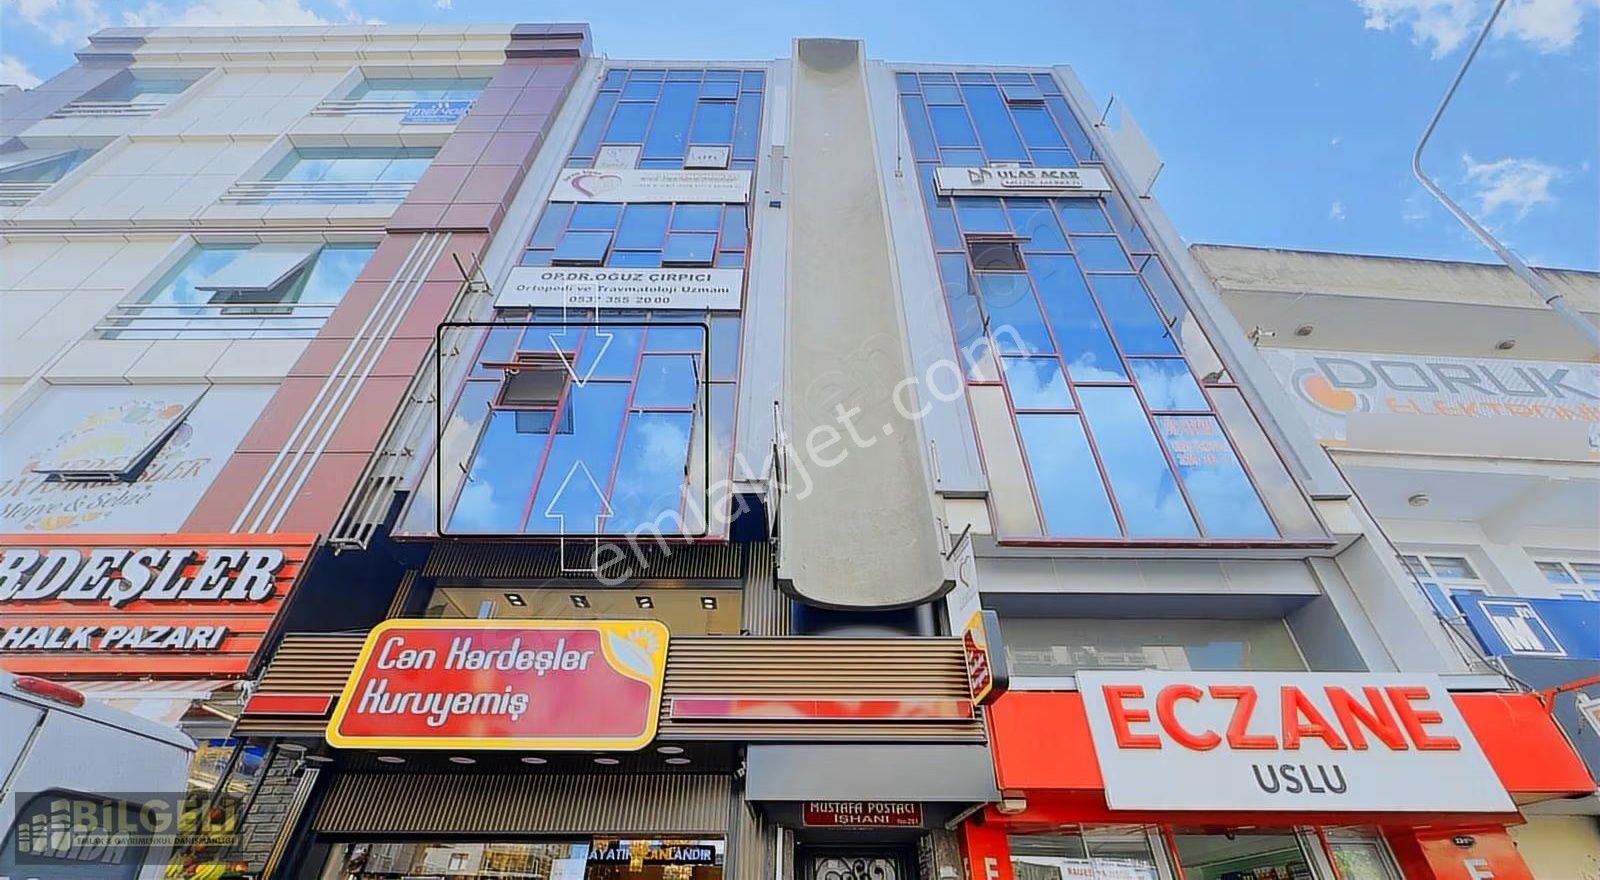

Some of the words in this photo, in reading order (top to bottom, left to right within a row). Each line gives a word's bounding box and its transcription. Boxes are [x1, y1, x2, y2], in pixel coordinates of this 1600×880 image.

[516, 284, 573, 293] Ortopedi
[597, 284, 678, 294] Travmatoloji
[1314, 356, 1600, 399] DORUK
[0, 626, 95, 650] HALK
[98, 626, 229, 650] PAZARI
[377, 636, 437, 671] Can
[1101, 683, 1462, 752] ECZANE
[1252, 763, 1348, 795] USLU
[810, 802, 863, 815] MUSTAFA
[867, 802, 915, 815] POSTACI
